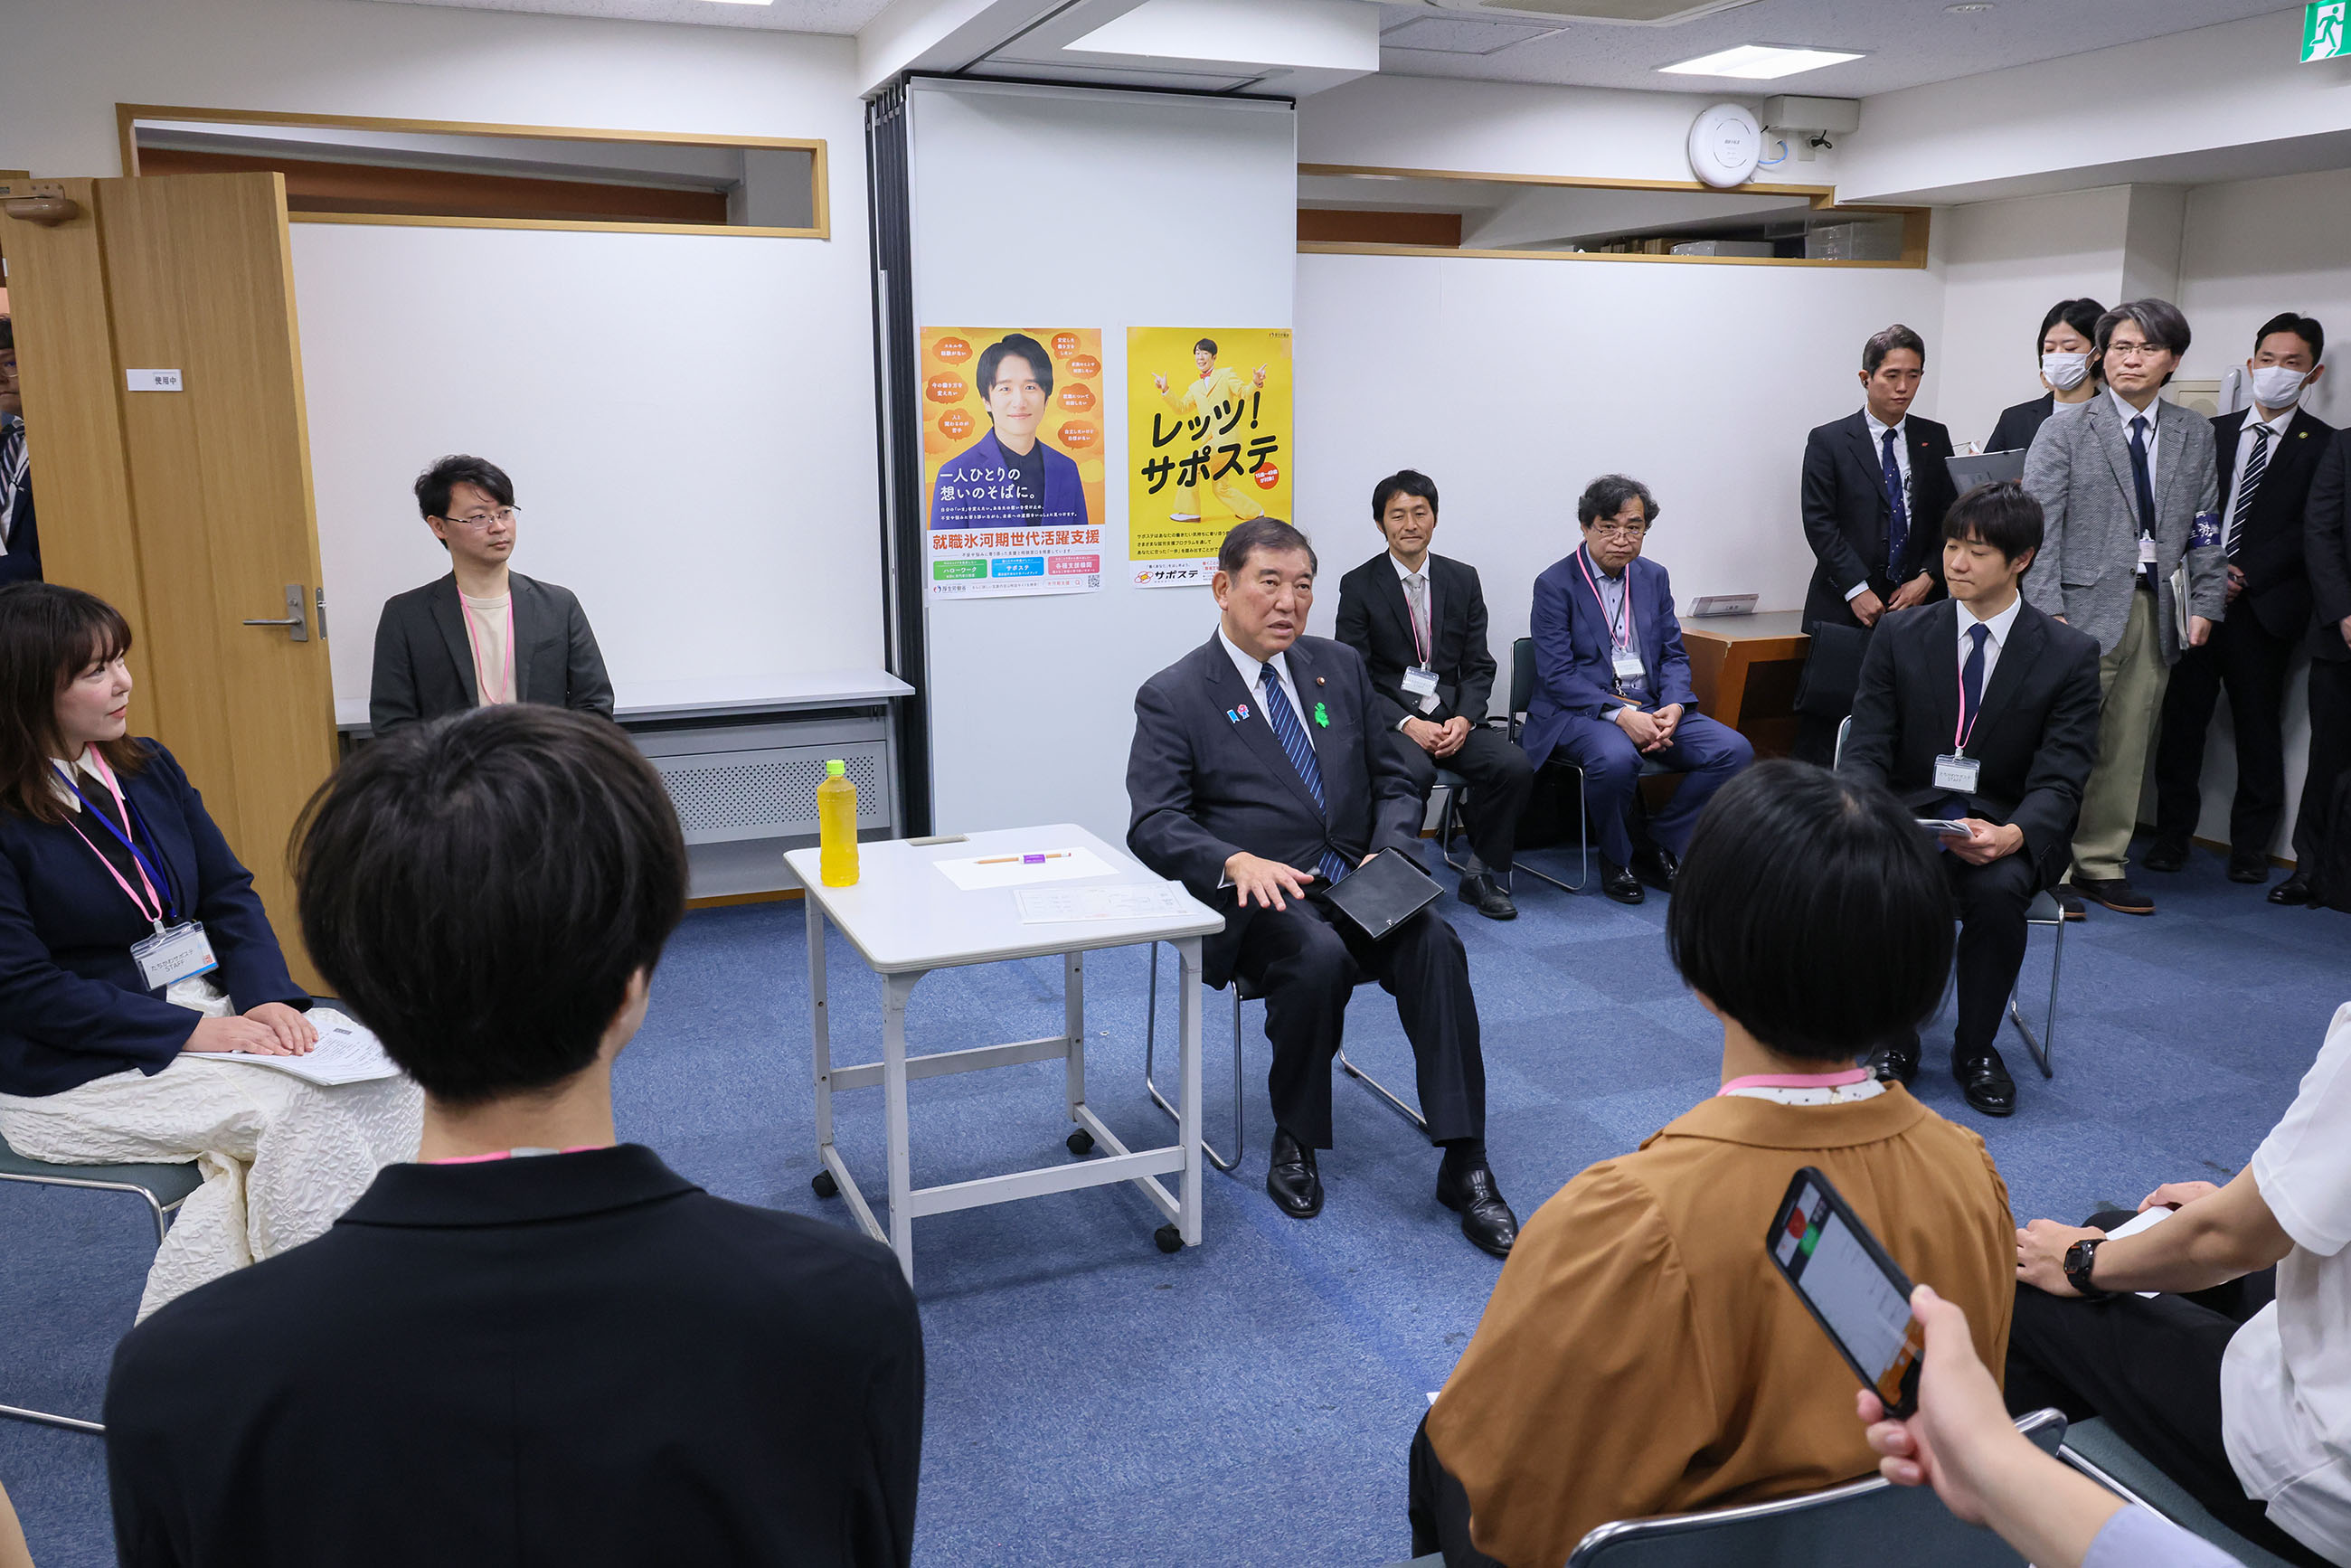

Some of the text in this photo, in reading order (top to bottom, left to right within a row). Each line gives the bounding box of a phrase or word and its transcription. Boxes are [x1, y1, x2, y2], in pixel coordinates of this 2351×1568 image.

[155, 376, 177, 385] 使用中
[1141, 435, 1279, 496] サポステ
[939, 467, 1021, 483] 一人ひとりの
[940, 484, 1035, 502] 想いのそばに。
[932, 529, 1100, 551] 就職氷河期世代活躍支援
[942, 565, 977, 574] ハローワーク
[1006, 563, 1030, 571] サポステ
[1154, 569, 1199, 580] サポステ
[165, 959, 185, 972] STAFF
